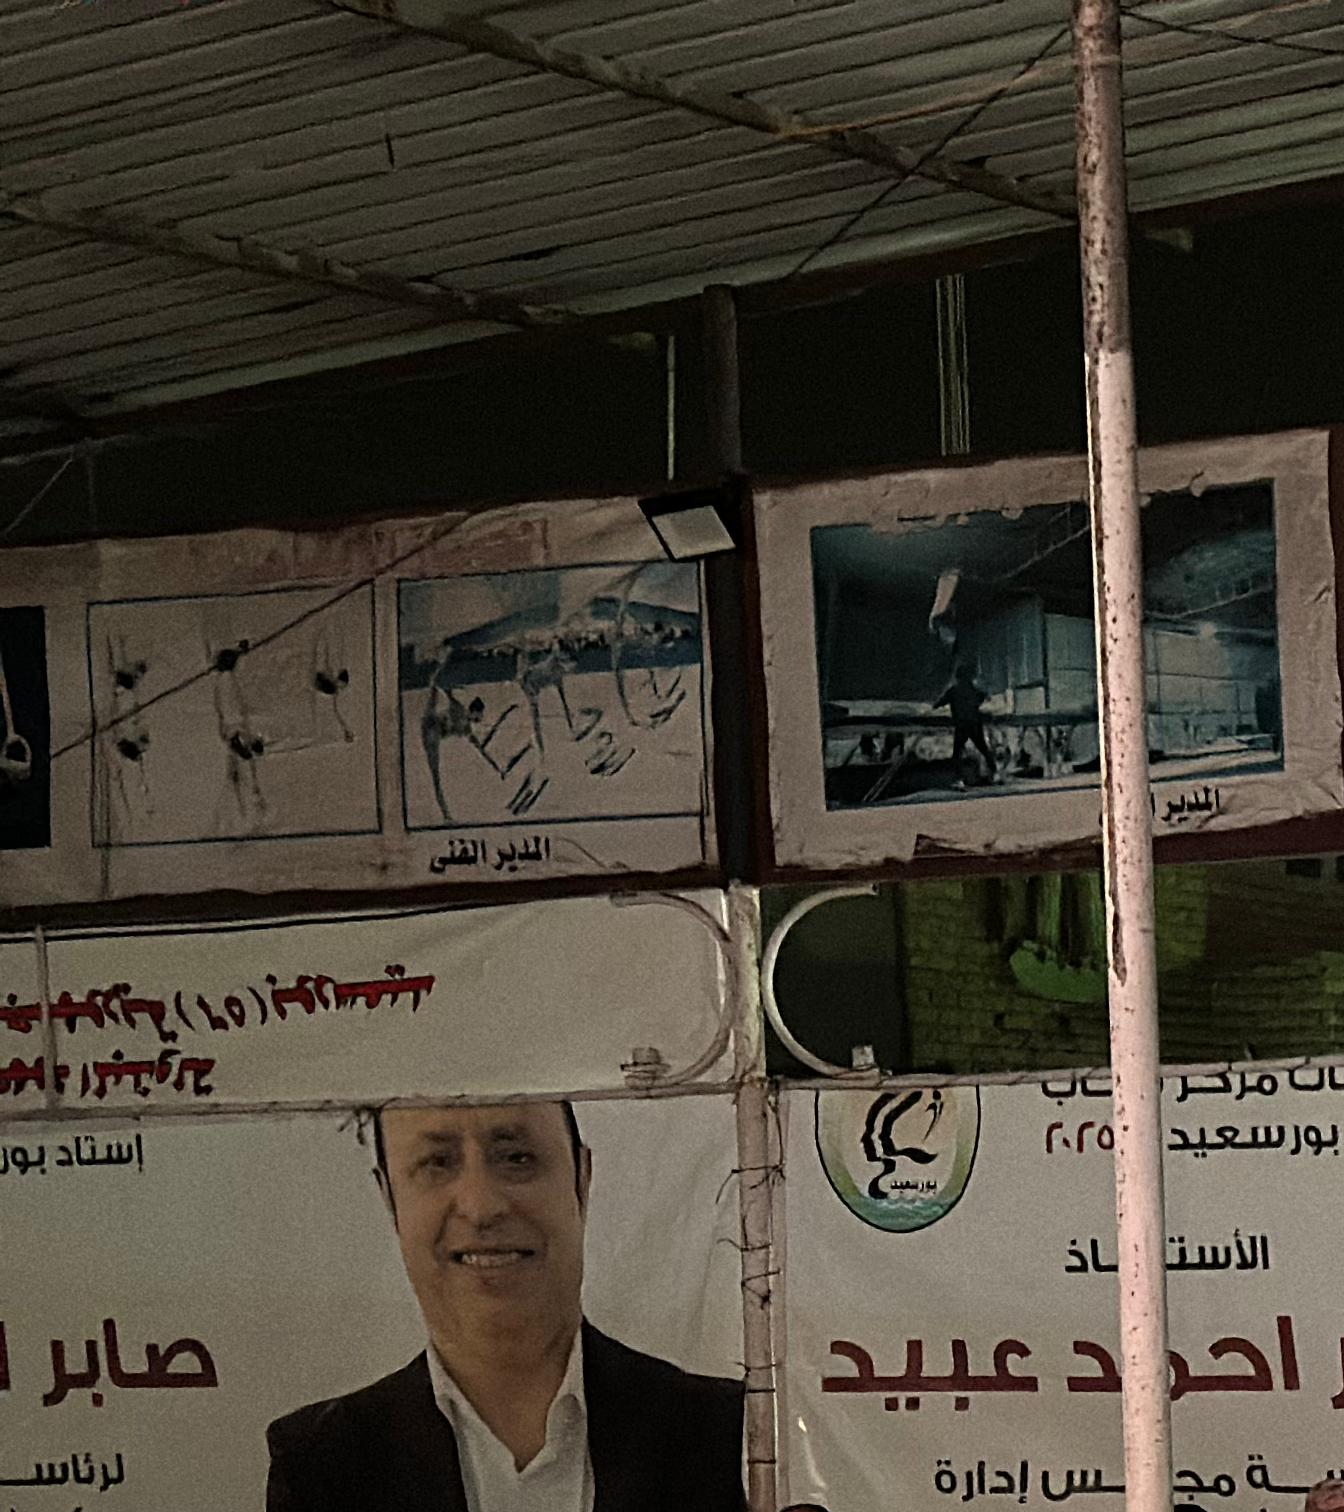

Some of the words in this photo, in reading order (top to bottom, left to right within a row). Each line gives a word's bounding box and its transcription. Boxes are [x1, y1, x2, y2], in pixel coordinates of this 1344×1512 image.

[1161, 786, 1220, 823] المدير
[491, 835, 549, 874] المدير
[1045, 1120, 1115, 1154] ٢٠٢٥
[1167, 1123, 1340, 1159] بورسعيد
[42, 1317, 219, 1408] صابر
[821, 1338, 1039, 1411] عبيد
[0, 1452, 125, 1493] لرئاس
[934, 1459, 1029, 1504] إدارة
[1041, 1468, 1236, 1502] مجس
